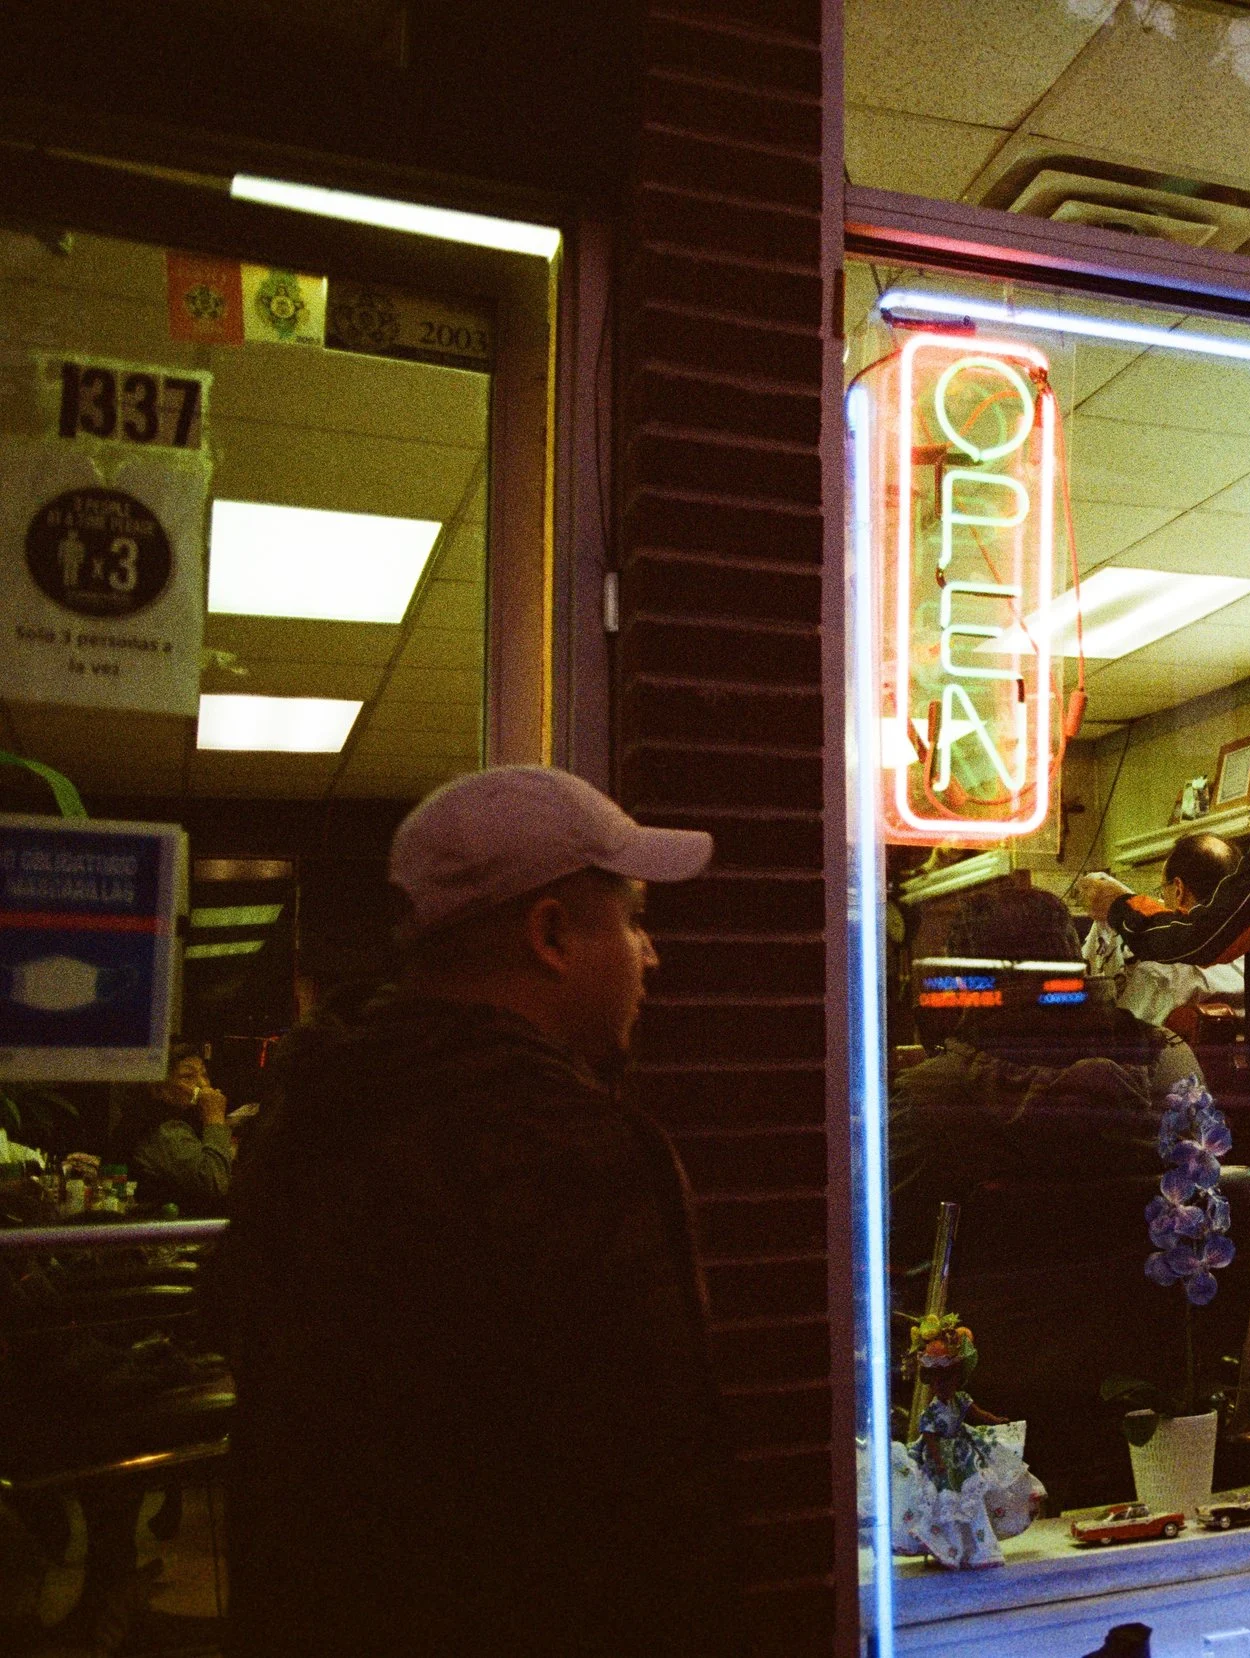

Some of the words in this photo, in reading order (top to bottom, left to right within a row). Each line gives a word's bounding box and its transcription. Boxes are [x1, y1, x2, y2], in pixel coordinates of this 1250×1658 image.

[420, 320, 487, 353] 2003
[59, 361, 202, 447] 1337
[108, 537, 139, 591] 3
[934, 356, 1034, 793] OPEN
